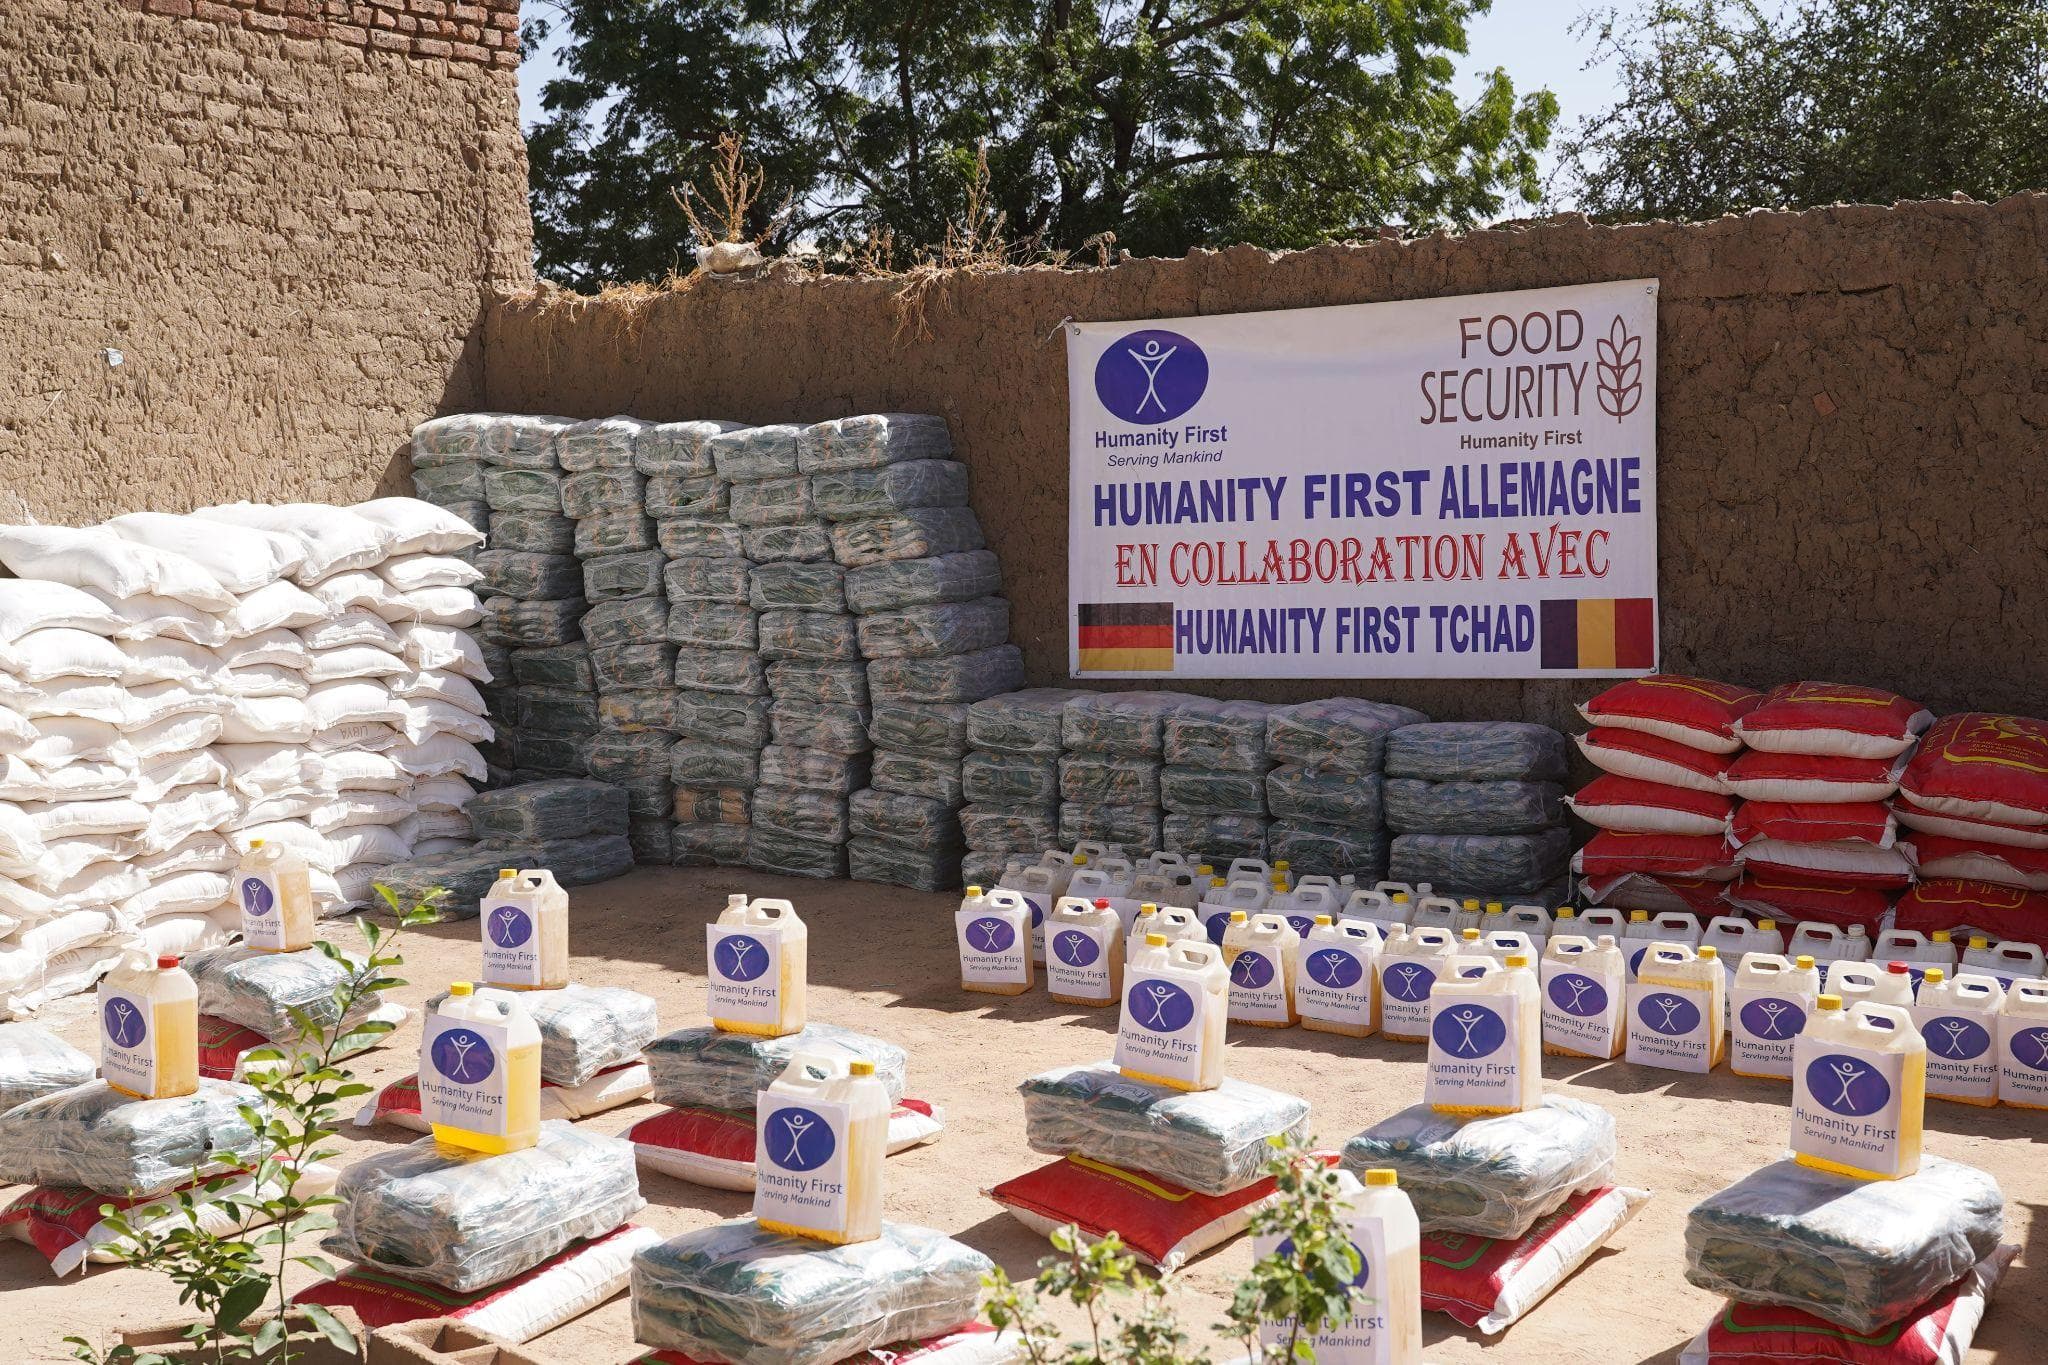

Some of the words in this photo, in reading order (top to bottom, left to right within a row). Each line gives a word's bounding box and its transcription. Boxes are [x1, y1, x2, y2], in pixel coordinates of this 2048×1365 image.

[1460, 309, 1583, 358] FOOD
[1420, 360, 1589, 425] SECURITY
[1095, 427, 1180, 451] Humanity
[1184, 424, 1228, 445] First
[1460, 430, 1540, 450] Humanity
[1544, 429, 1583, 446] First
[1107, 452, 1159, 468] Serving
[1163, 449, 1223, 465] Mankind
[1094, 476, 1287, 527] HUMANITY
[1304, 469, 1431, 520] FIRST
[1439, 456, 1642, 520] ALLEMAGNE
[1115, 542, 1160, 588] EN
[1169, 533, 1486, 586] COLLABORATION
[1498, 522, 1611, 580] AVEC
[1175, 607, 1327, 655] HUMANITY
[1336, 606, 1421, 654] FIRST
[1430, 604, 1535, 655] TCHAD
[483, 950, 517, 962] Humanity
[518, 952, 538, 962] First
[963, 955, 1002, 965] Humanity
[1050, 965, 1086, 980] Humanity
[1087, 971, 1107, 979] First
[710, 981, 750, 998] Humanity
[753, 986, 777, 997] First
[1228, 990, 1261, 1001] umanity
[1263, 992, 1283, 1000] First
[1298, 986, 1344, 1002] Humanity
[1346, 993, 1368, 1003] First
[1542, 1008, 1585, 1030] Humanity
[1587, 1021, 1611, 1035] First
[1121, 1027, 1169, 1050] Humanity
[1172, 1038, 1198, 1053] First
[1631, 1031, 1681, 1050] Humanity
[1682, 1040, 1707, 1050] First
[1735, 1038, 1786, 1053] Humanity
[133, 1054, 153, 1068] First
[1125, 1043, 1151, 1058] Serving
[1152, 1048, 1189, 1063] Mankind
[1741, 1052, 1769, 1062] Serving
[1771, 1053, 1793, 1062] Mank
[1429, 1063, 1483, 1077] Humanity
[1486, 1063, 1516, 1075] First
[1926, 1062, 1970, 1074] umanity
[1974, 1064, 1999, 1073] First
[2003, 1067, 2048, 1082] Humani
[1434, 1078, 1465, 1089] Serving
[1466, 1078, 1506, 1088] Mankind
[1955, 1075, 1991, 1083] Mankind
[2012, 1081, 2042, 1093] Serving
[422, 1080, 473, 1104] Humanity
[476, 1091, 503, 1105] First
[1796, 1106, 1860, 1137] Humanity
[1863, 1124, 1896, 1141] First
[1804, 1126, 1837, 1146] Serving
[1839, 1135, 1885, 1153] Mankind
[812, 1178, 843, 1195] First
[790, 1194, 831, 1208] Mankind
[1319, 1334, 1371, 1348] Mankind
